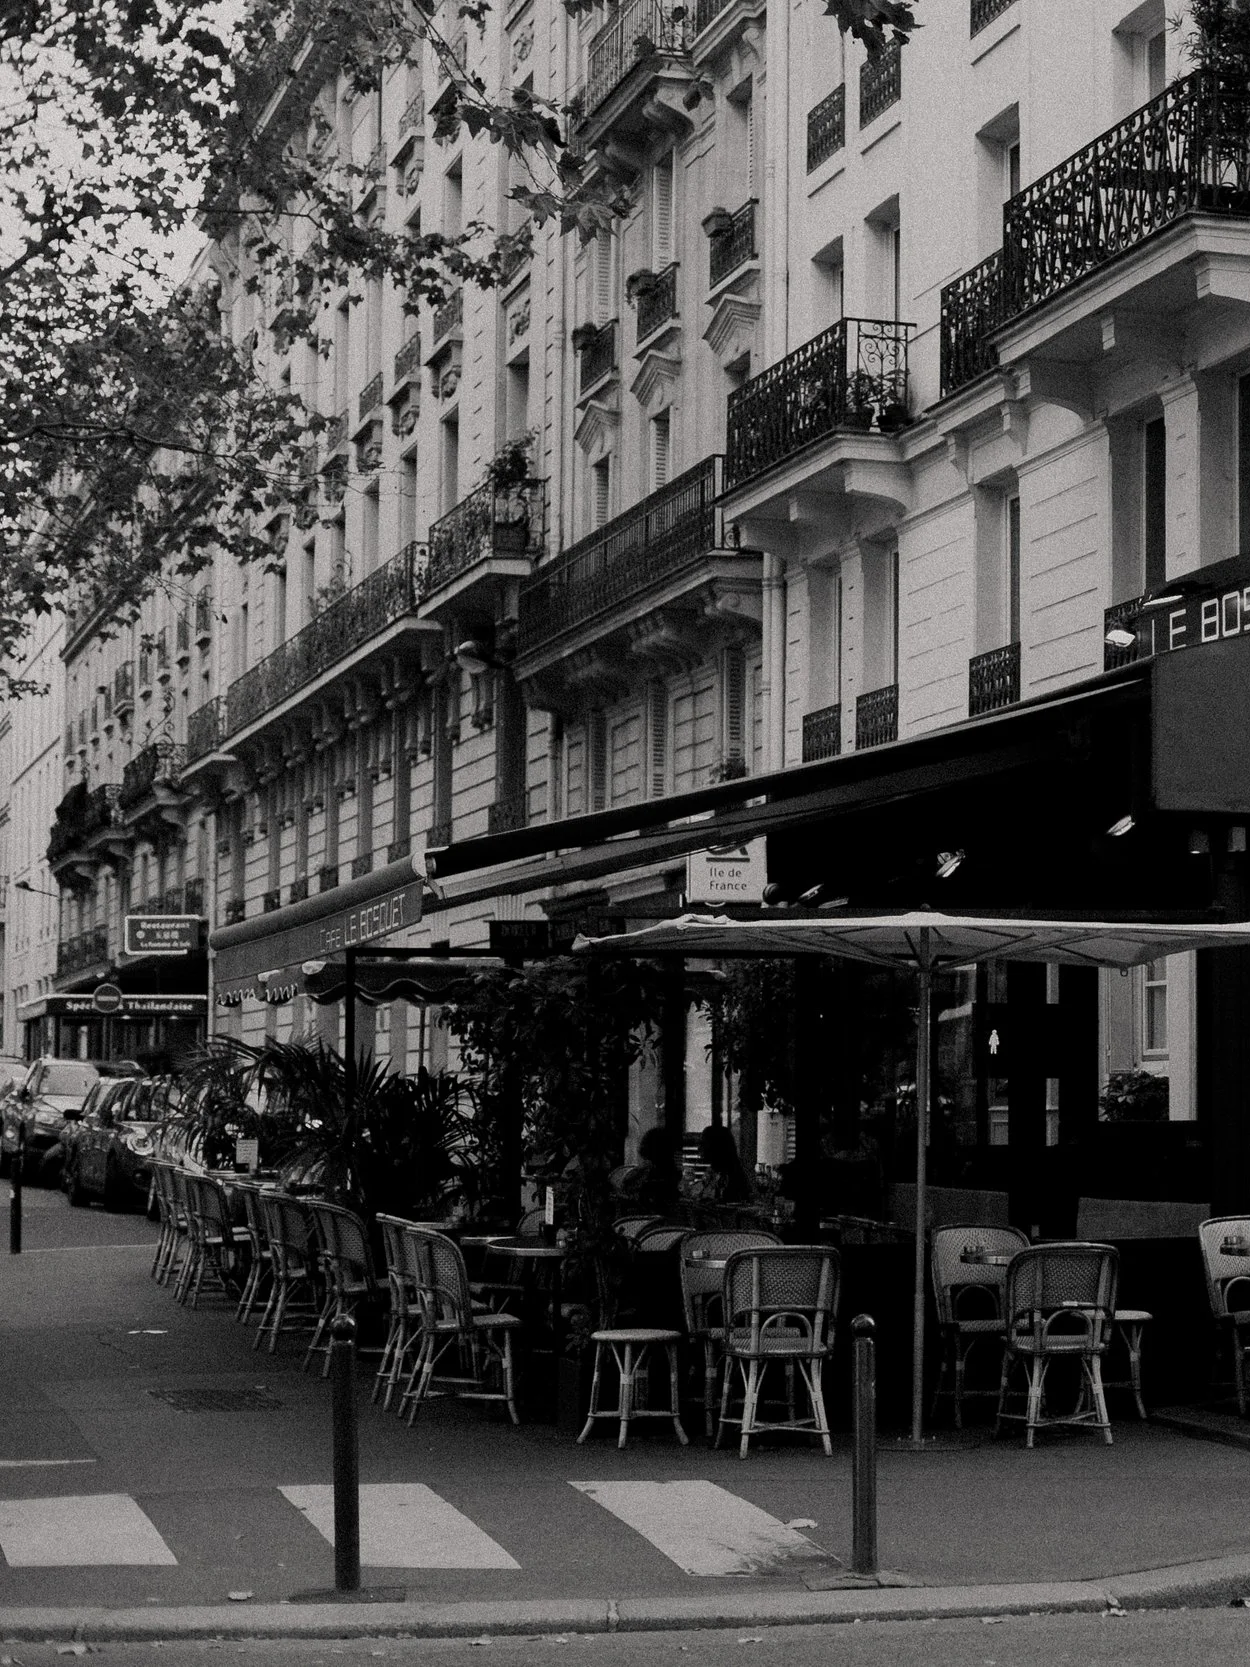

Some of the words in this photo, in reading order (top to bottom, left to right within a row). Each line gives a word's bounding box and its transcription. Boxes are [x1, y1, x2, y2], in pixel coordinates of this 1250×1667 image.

[727, 867, 743, 878] de
[709, 880, 748, 891] France
[360, 893, 406, 941] BOSQUET
